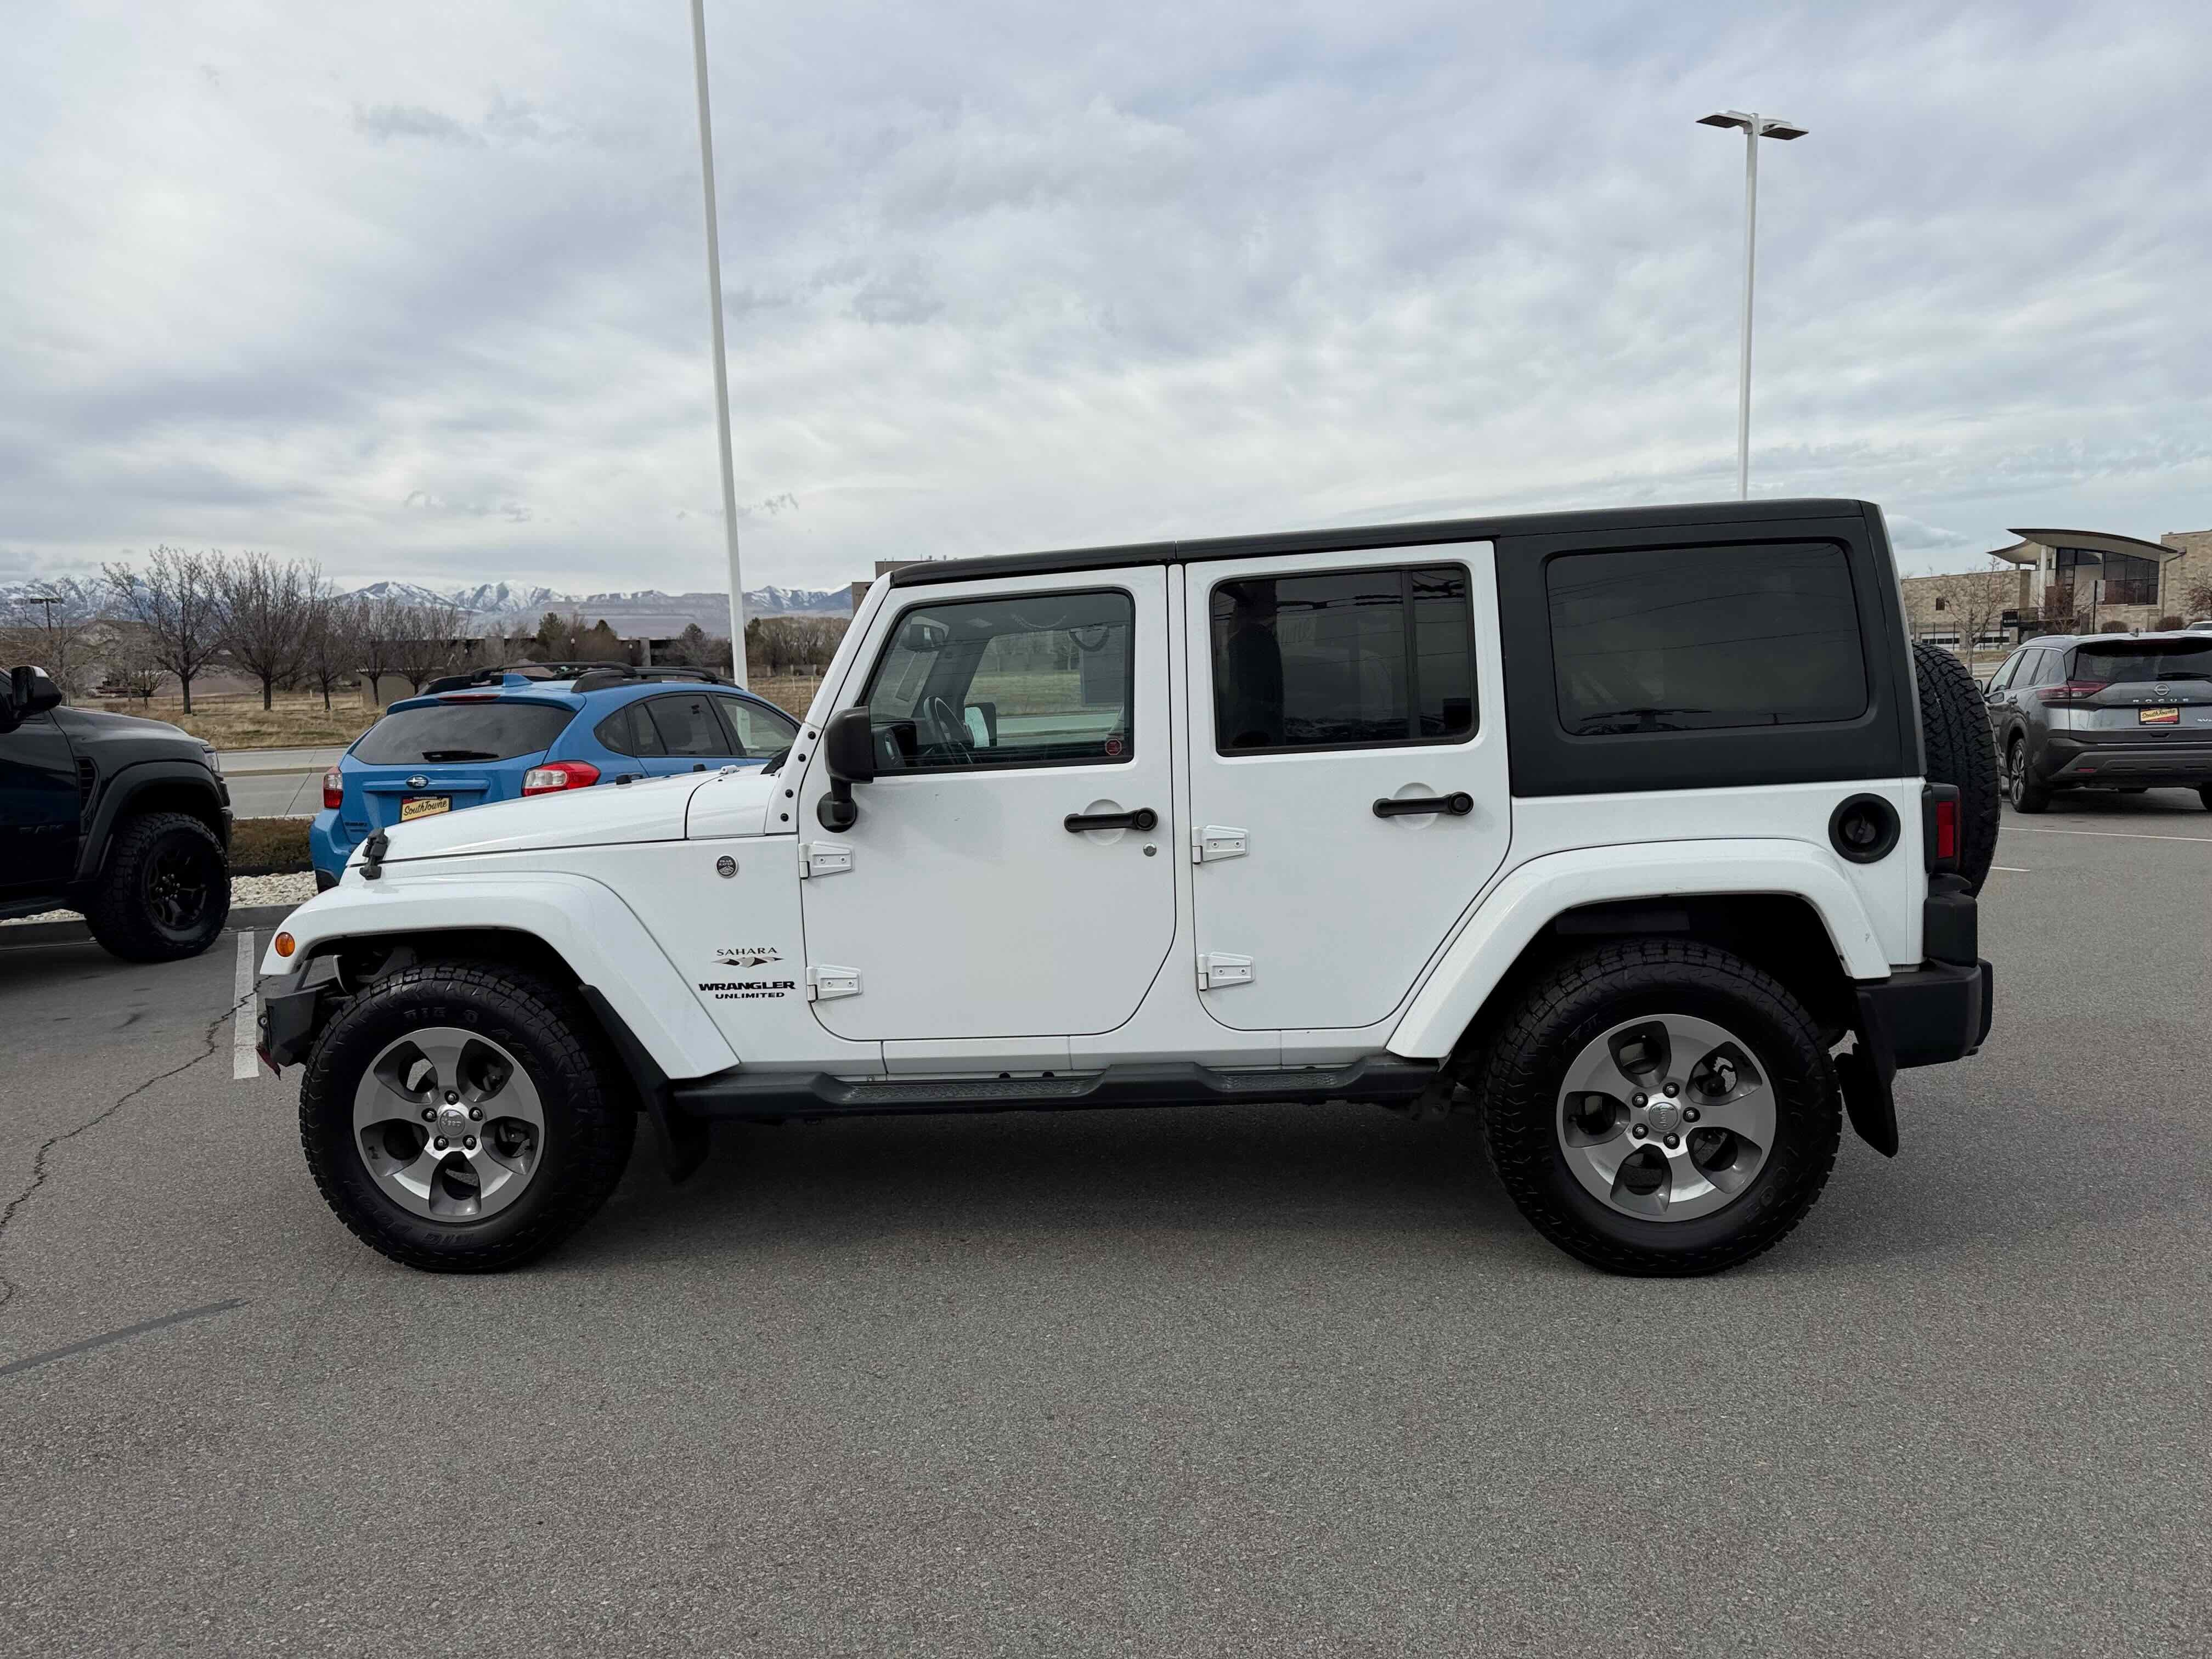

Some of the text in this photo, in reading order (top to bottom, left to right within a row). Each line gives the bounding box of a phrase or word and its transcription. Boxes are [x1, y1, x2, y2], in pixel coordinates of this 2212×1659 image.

[403, 800, 448, 816] SouthTowne
[716, 947, 777, 956] SAHARA
[698, 981, 796, 991] WRANGLER
